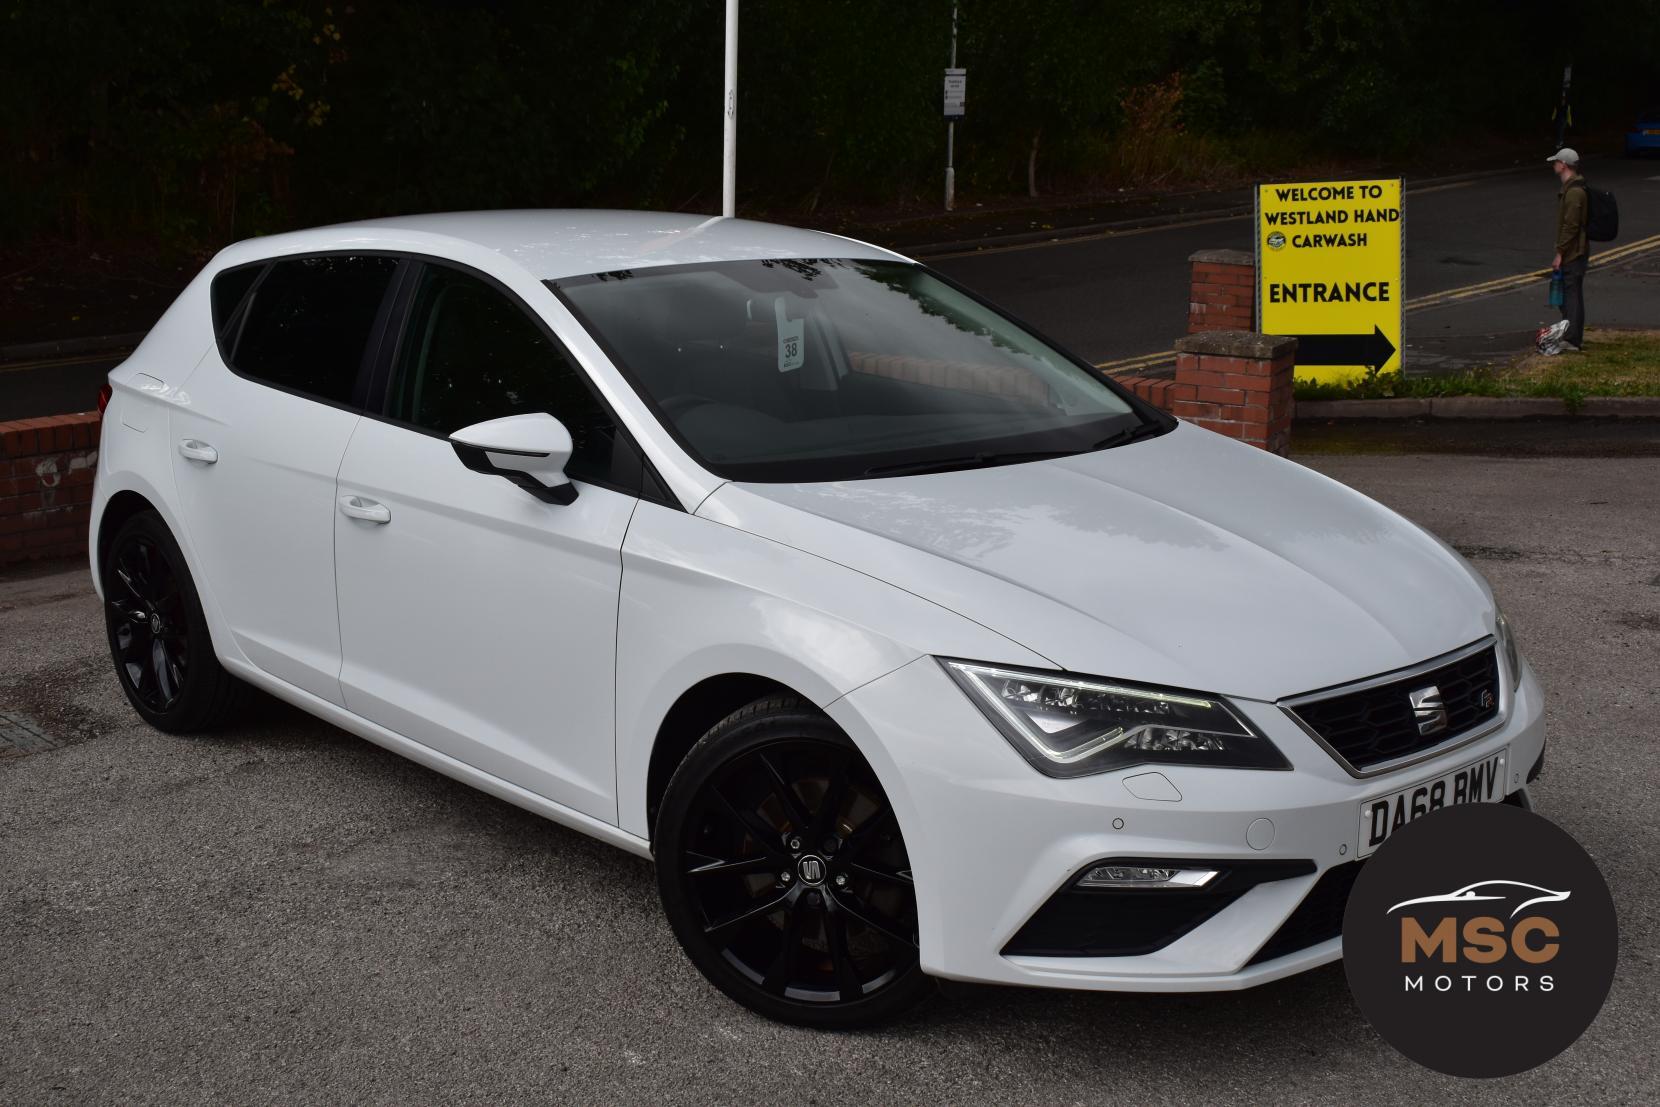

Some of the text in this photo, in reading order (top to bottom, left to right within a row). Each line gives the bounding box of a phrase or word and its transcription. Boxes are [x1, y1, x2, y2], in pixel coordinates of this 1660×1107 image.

[1275, 185, 1382, 202] WELCOME TO
[1265, 208, 1399, 225] WESTLAND HAND
[1292, 233, 1367, 248] CARWASH
[1269, 282, 1389, 303] ENTRANCE
[785, 343, 797, 358] 38
[1369, 780, 1445, 847] DA68
